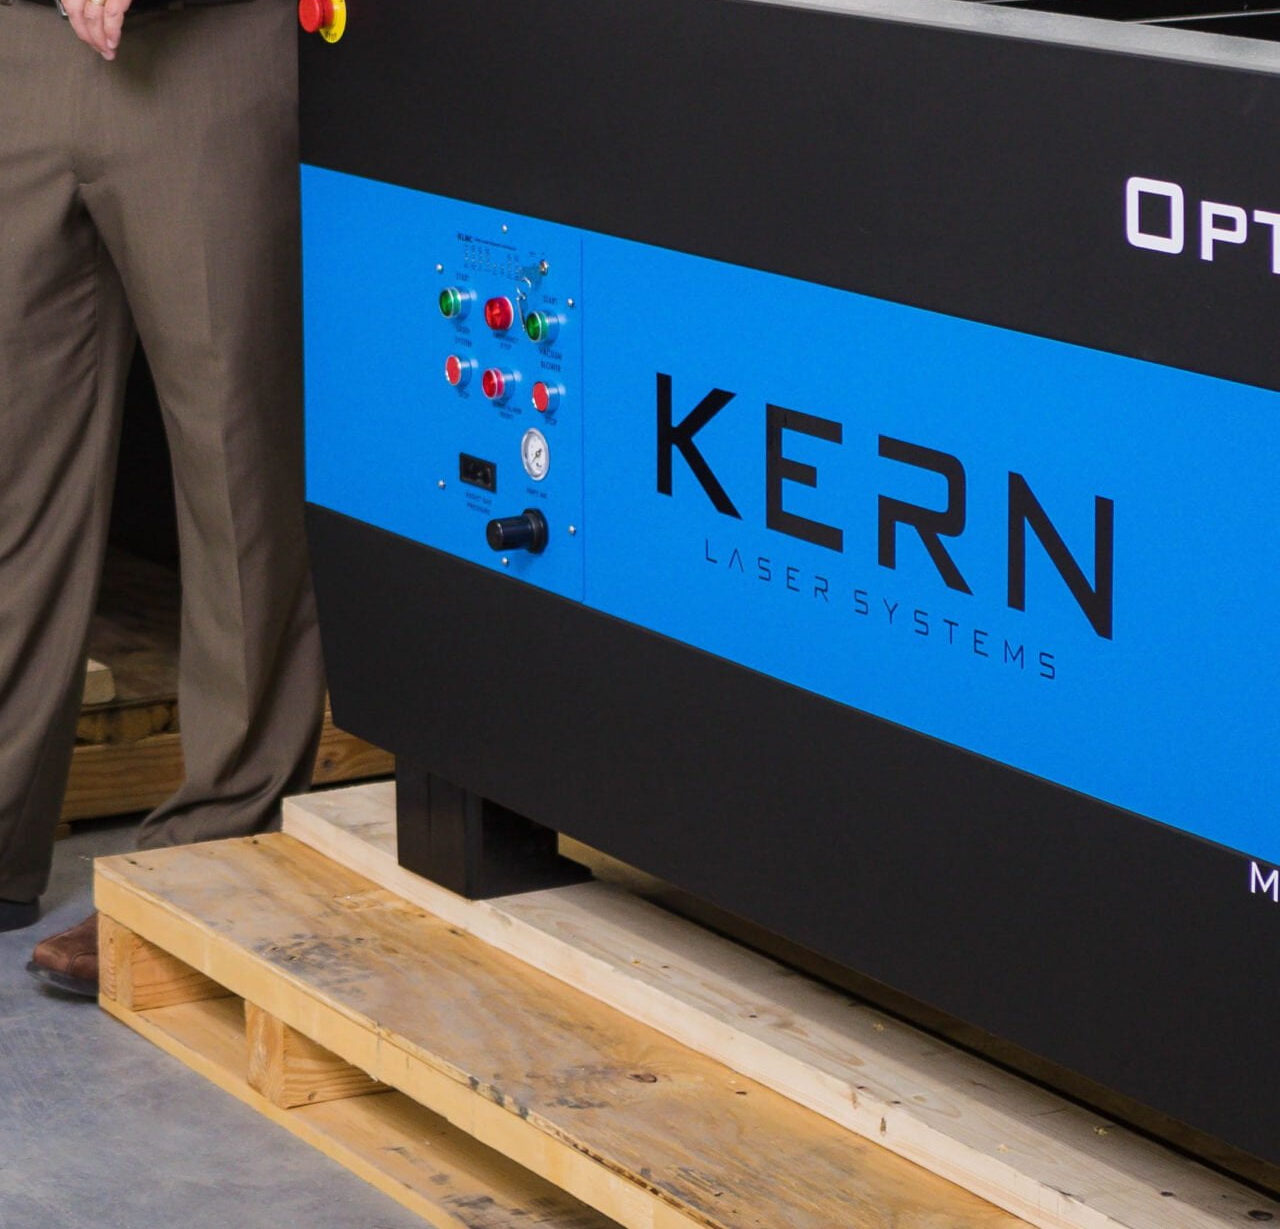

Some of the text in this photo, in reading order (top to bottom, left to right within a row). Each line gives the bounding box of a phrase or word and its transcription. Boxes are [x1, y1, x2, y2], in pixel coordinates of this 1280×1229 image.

[656, 372, 1114, 640] KERN
[705, 538, 1056, 680] LASER SYSTEMS
